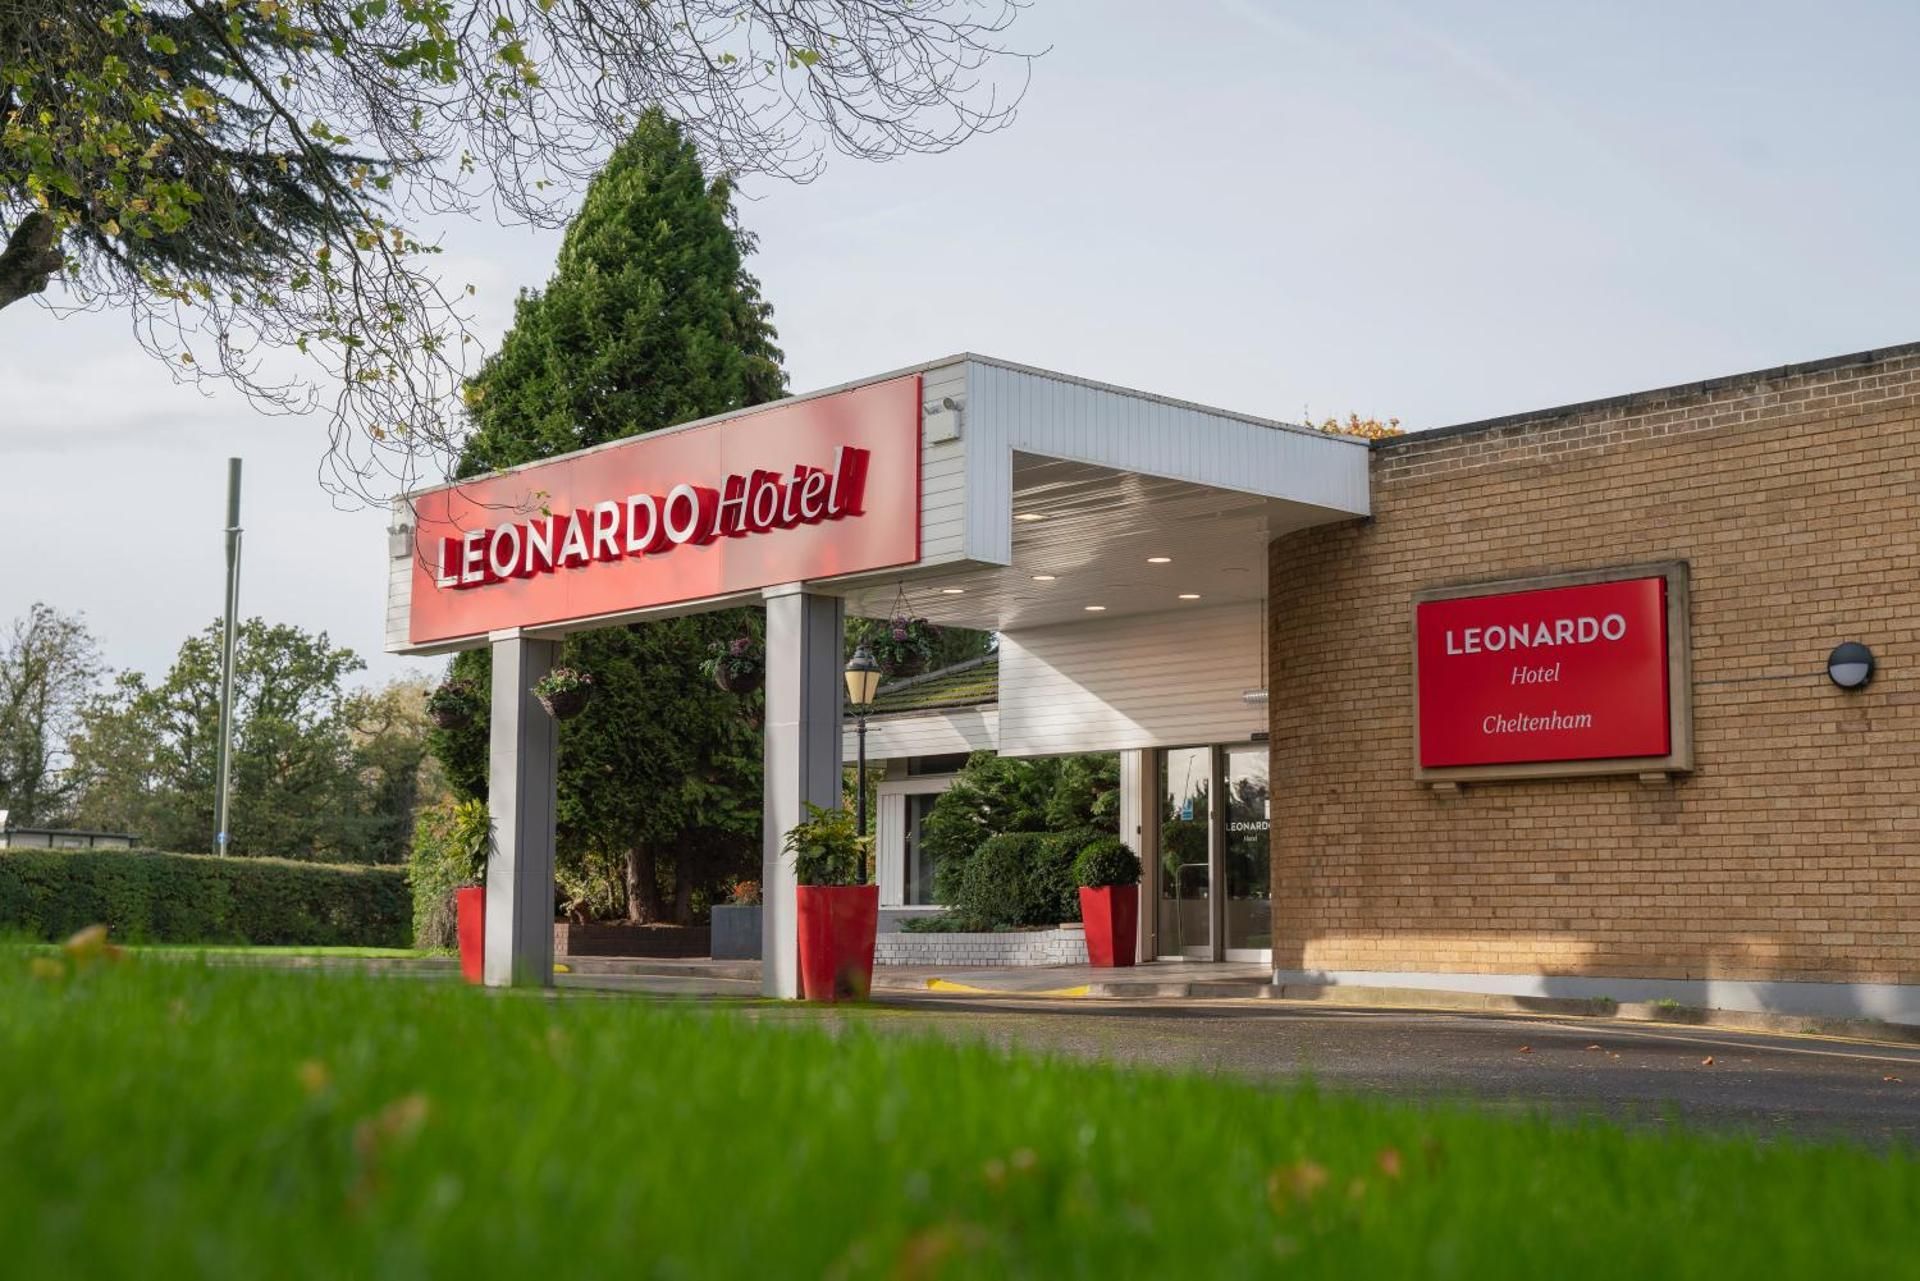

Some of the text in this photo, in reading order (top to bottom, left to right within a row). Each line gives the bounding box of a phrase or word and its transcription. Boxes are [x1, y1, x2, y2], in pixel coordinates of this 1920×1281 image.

[437, 446, 846, 589] LEONARDO Hotel
[1445, 613, 1627, 656] LEONARDO
[1511, 662, 1561, 686] Hotel
[1482, 710, 1593, 735] Cheltenham
